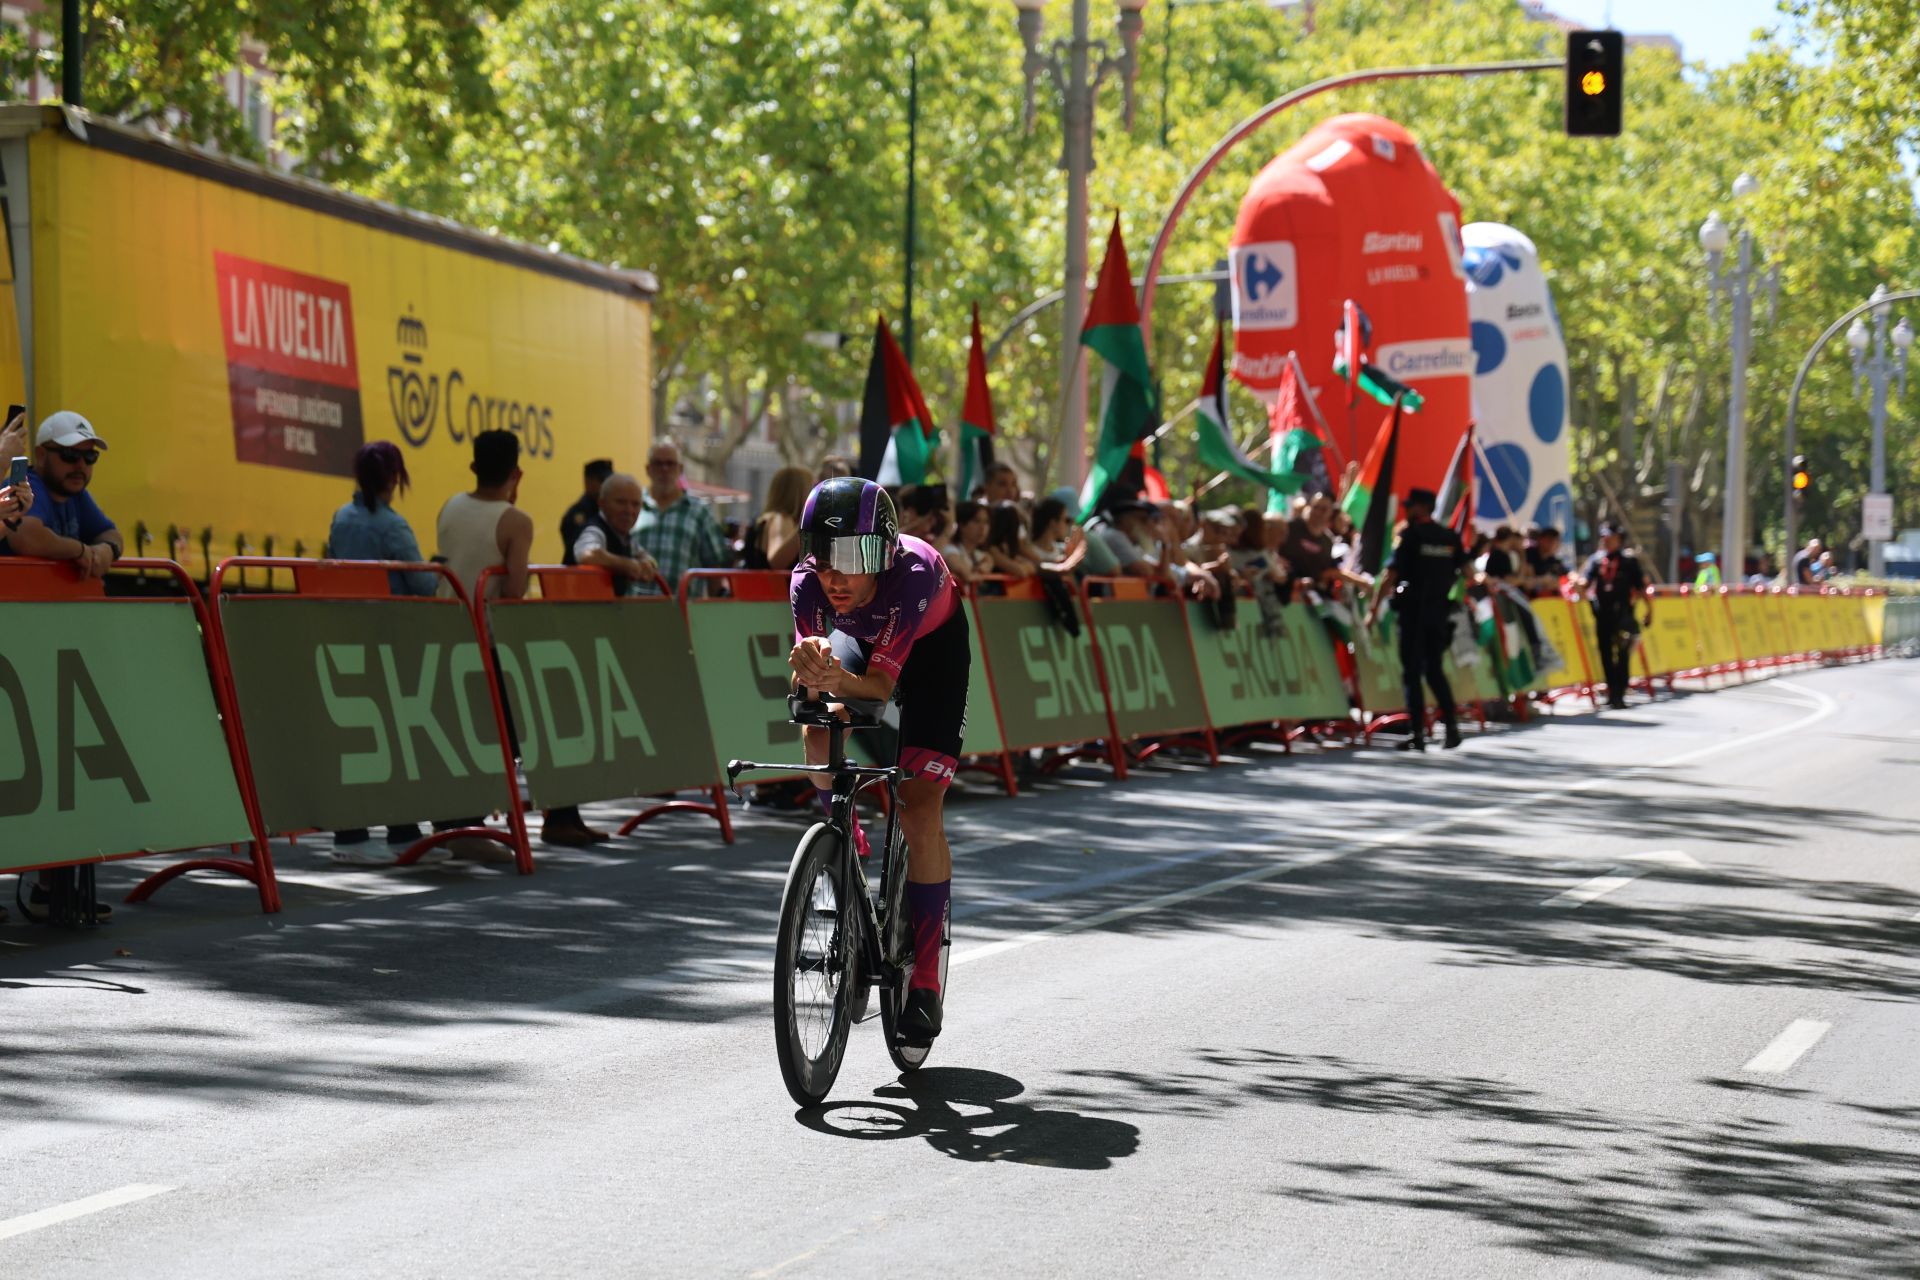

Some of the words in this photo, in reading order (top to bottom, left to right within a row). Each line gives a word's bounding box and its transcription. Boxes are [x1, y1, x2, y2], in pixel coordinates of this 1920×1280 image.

[230, 275, 262, 349] LA
[261, 282, 347, 368] VUELTA
[446, 369, 554, 460] Correos
[924, 760, 956, 781] BH
[831, 794, 849, 804] BH
